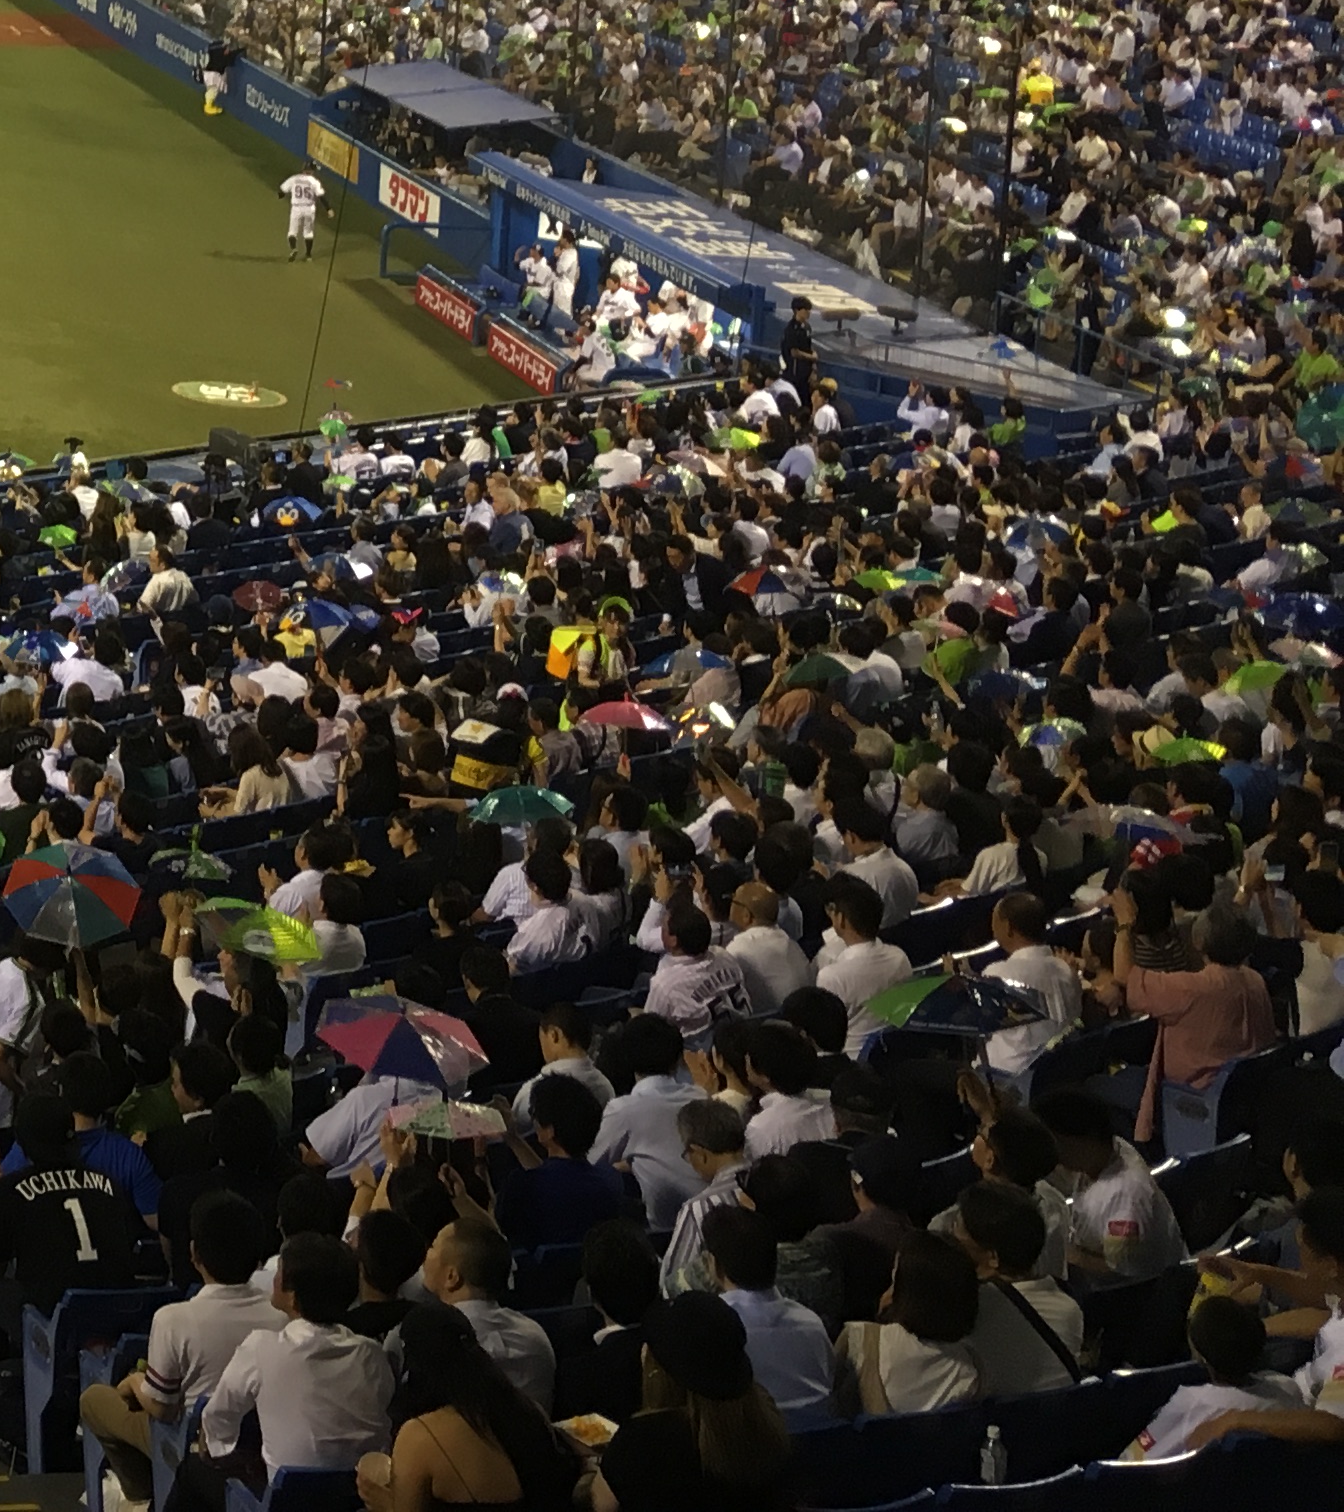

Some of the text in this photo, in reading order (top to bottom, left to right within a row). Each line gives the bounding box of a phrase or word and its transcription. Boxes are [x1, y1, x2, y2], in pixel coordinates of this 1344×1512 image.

[389, 173, 430, 223] タフマン
[15, 1169, 114, 1201] UCHIKAWA
[63, 1197, 98, 1261] 1
